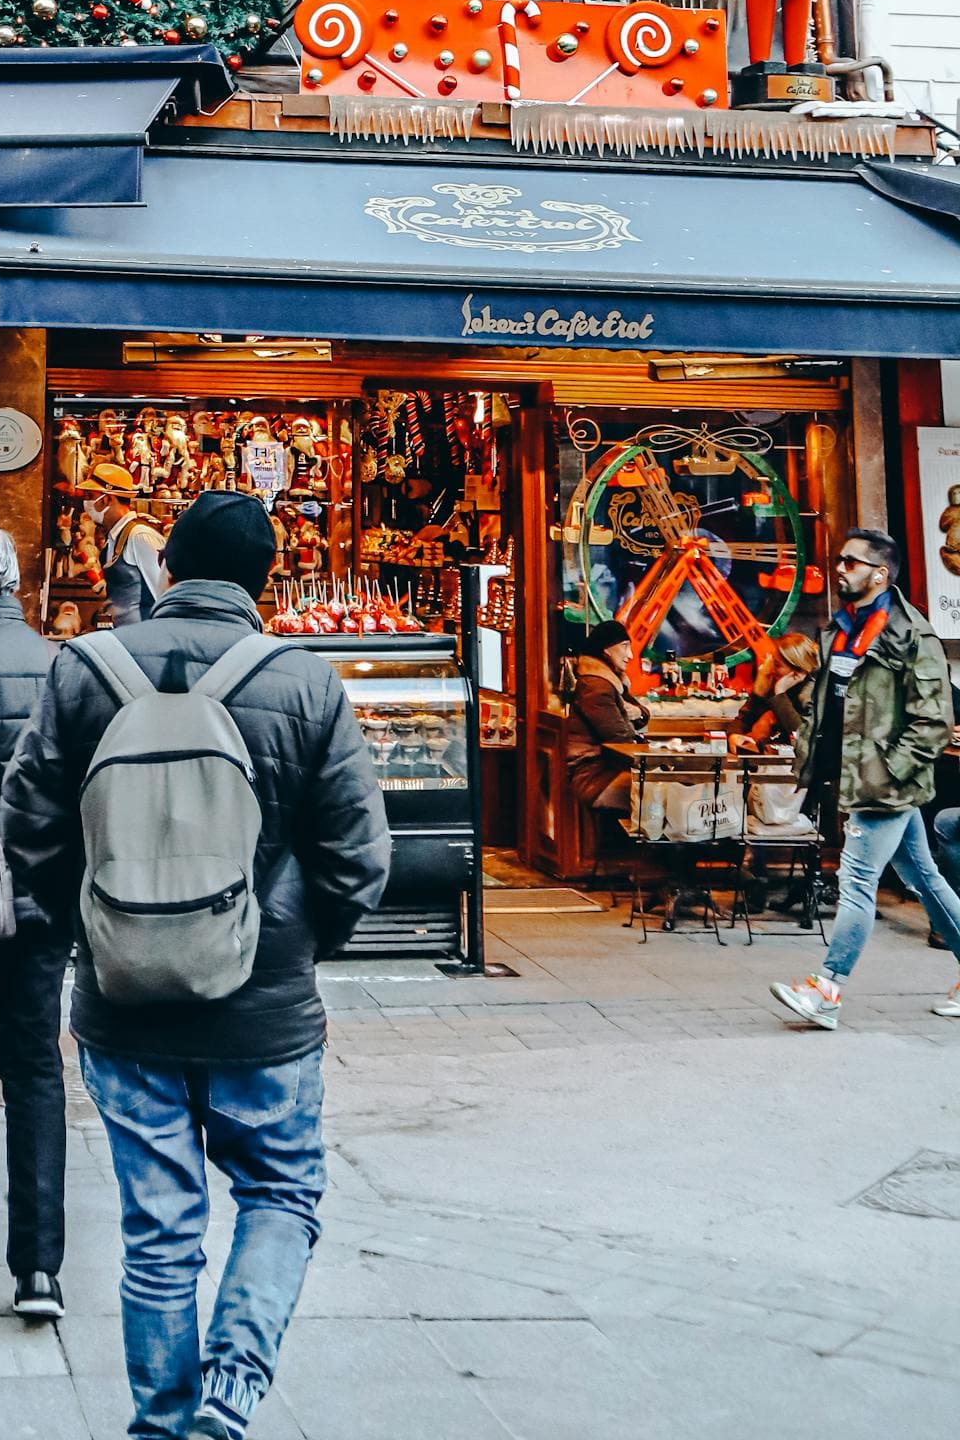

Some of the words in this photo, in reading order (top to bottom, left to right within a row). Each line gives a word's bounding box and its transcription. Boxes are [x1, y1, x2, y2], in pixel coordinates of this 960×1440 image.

[408, 212, 514, 229] Cafer
[513, 214, 598, 231] Erol
[536, 309, 602, 342] Cafer
[601, 310, 655, 340] Erol
